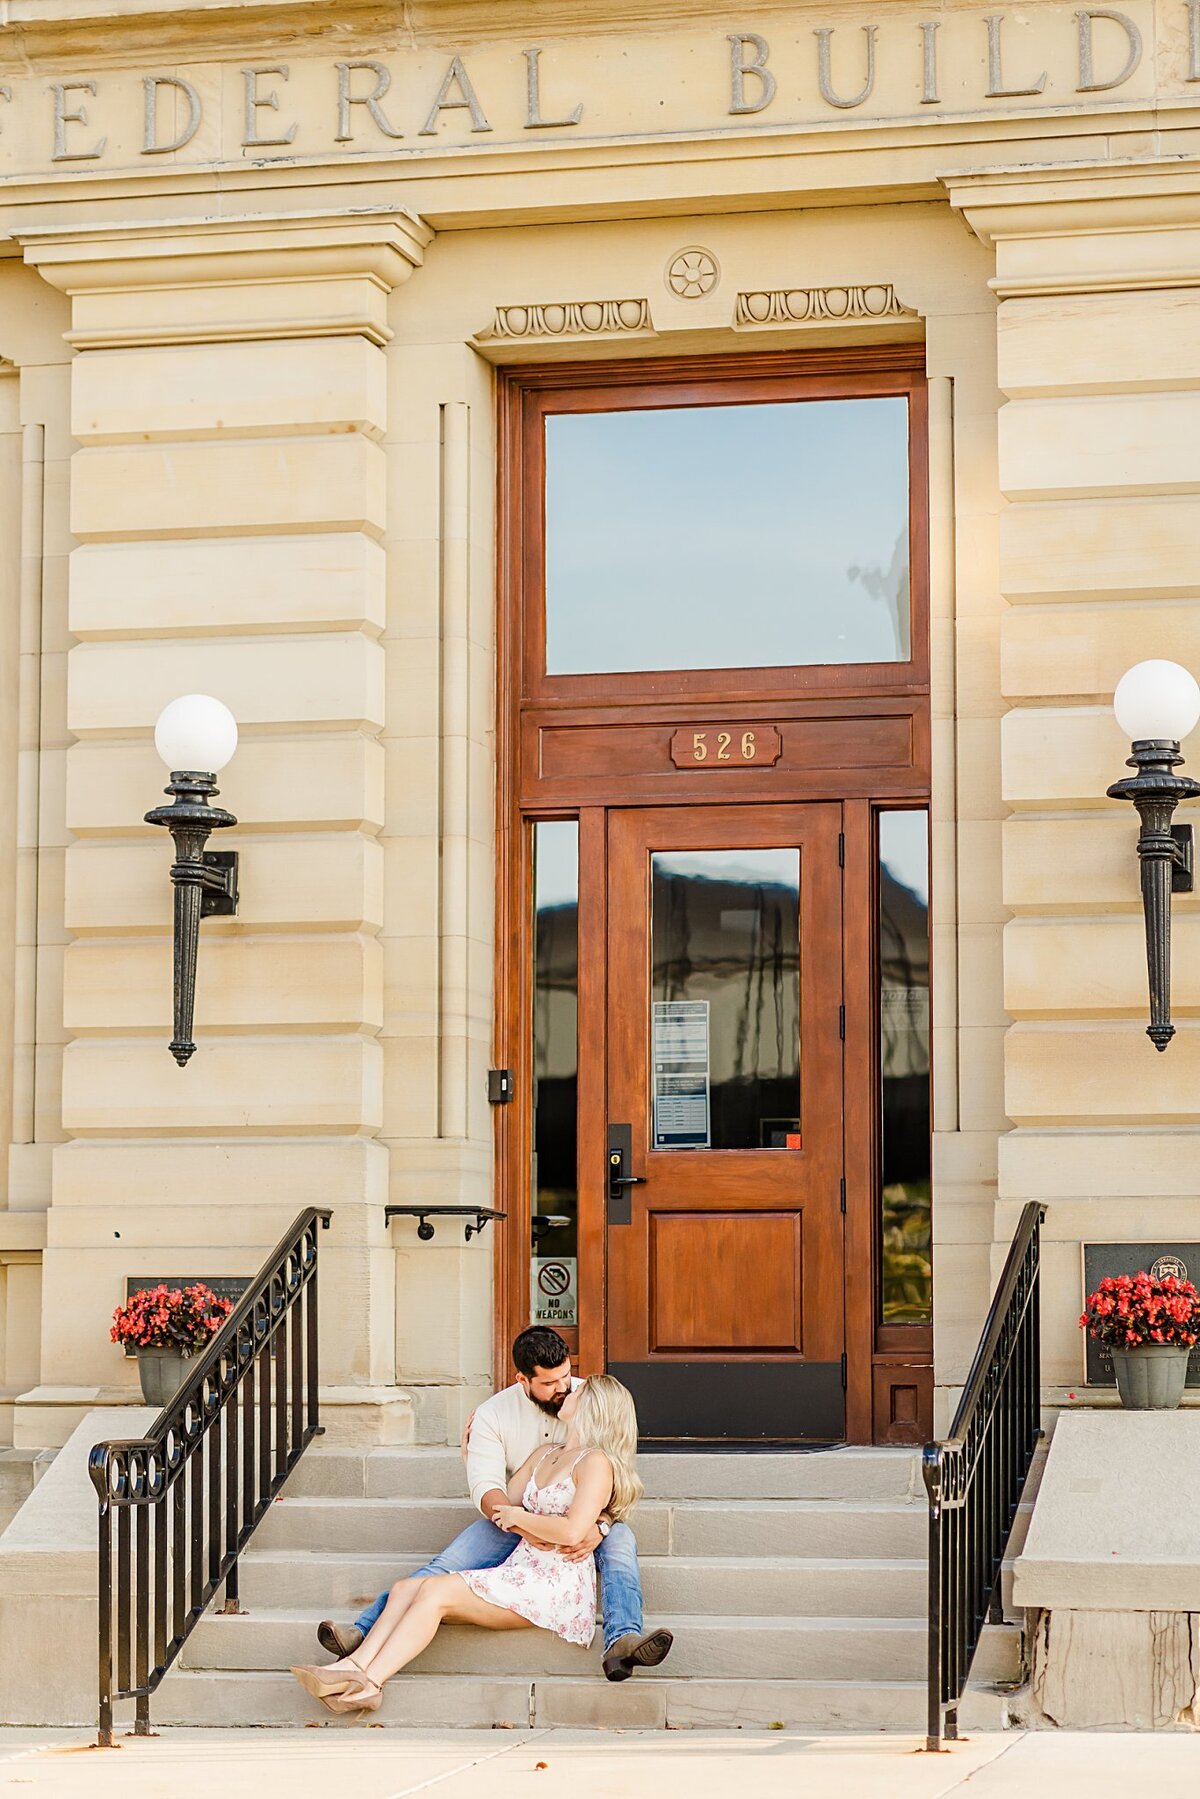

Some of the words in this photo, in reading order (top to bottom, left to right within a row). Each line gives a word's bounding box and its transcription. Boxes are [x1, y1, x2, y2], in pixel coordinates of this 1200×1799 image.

[0, 48, 585, 162] EDERAL
[693, 732, 756, 761] 526
[548, 1299, 560, 1308] NO
[535, 1310, 574, 1319] WEAPONS
